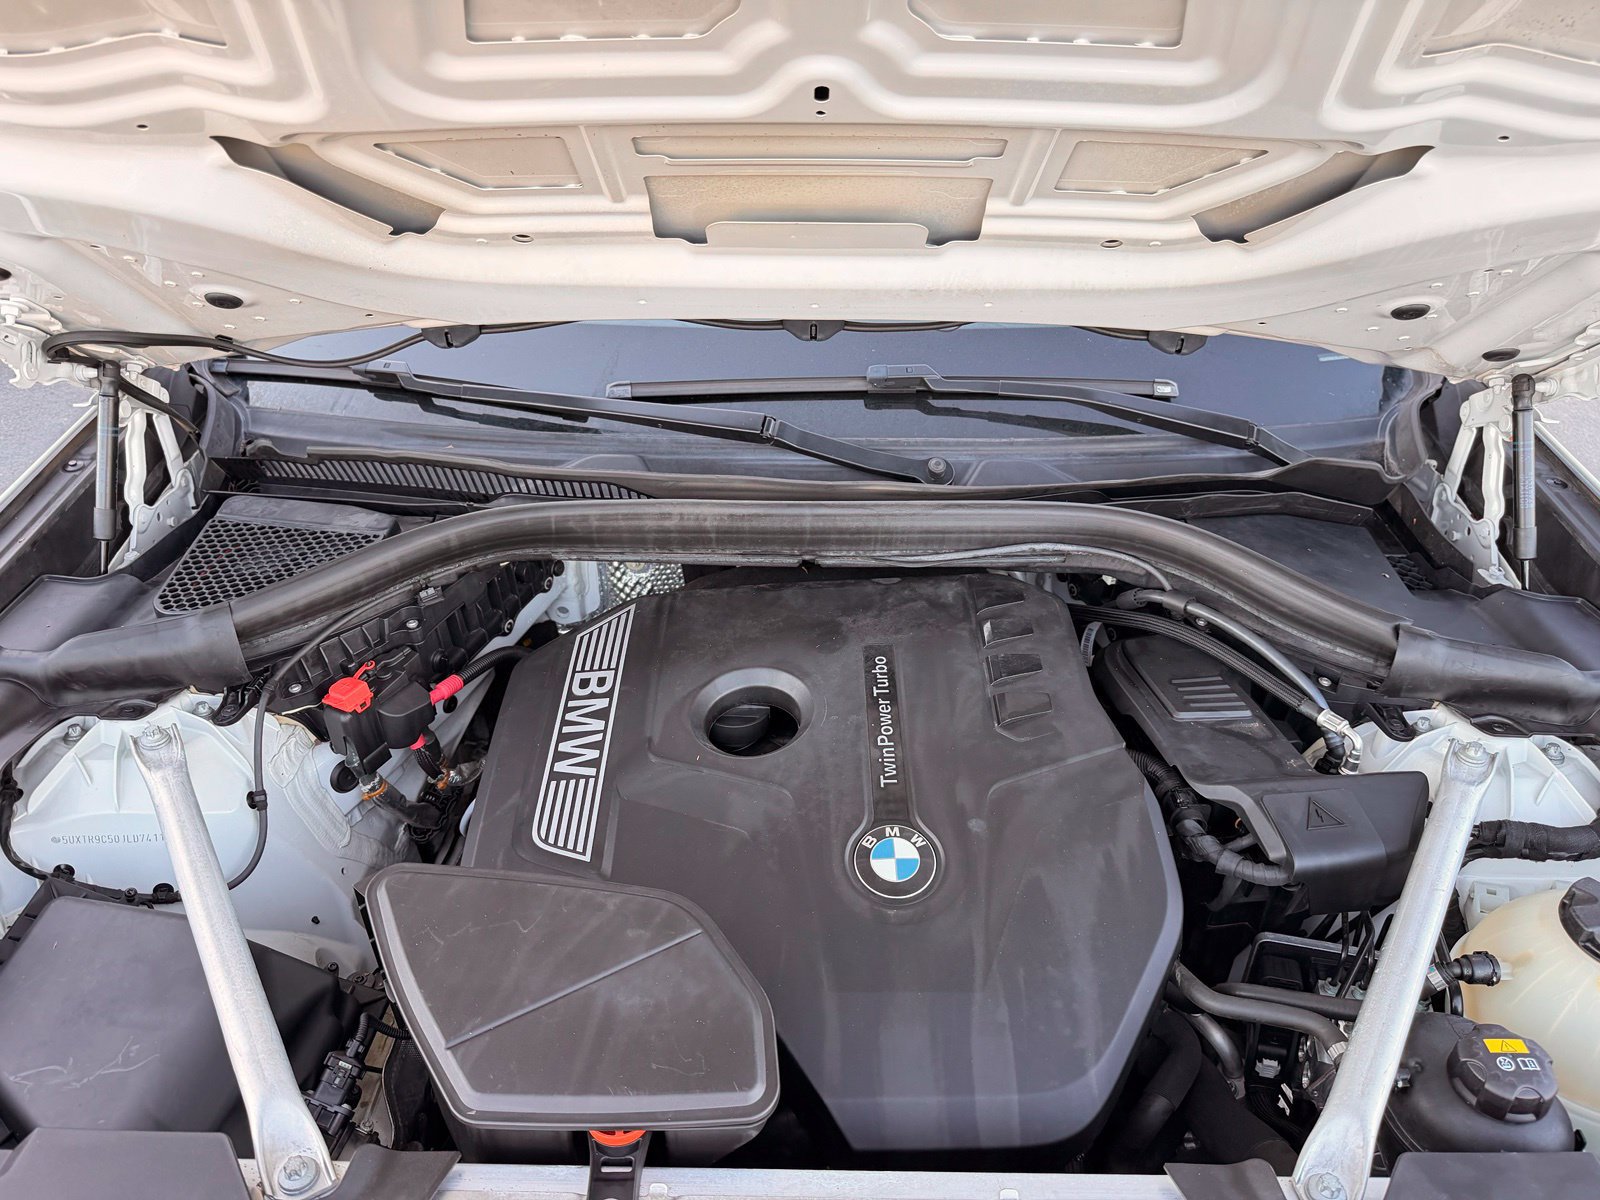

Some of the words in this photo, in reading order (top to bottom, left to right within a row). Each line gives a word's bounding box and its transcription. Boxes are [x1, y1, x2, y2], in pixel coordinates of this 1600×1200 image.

[871, 655, 890, 697] Turbo
[553, 669, 616, 777] BMW
[877, 698, 898, 788] TwinPower
[861, 826, 927, 849] BMW
